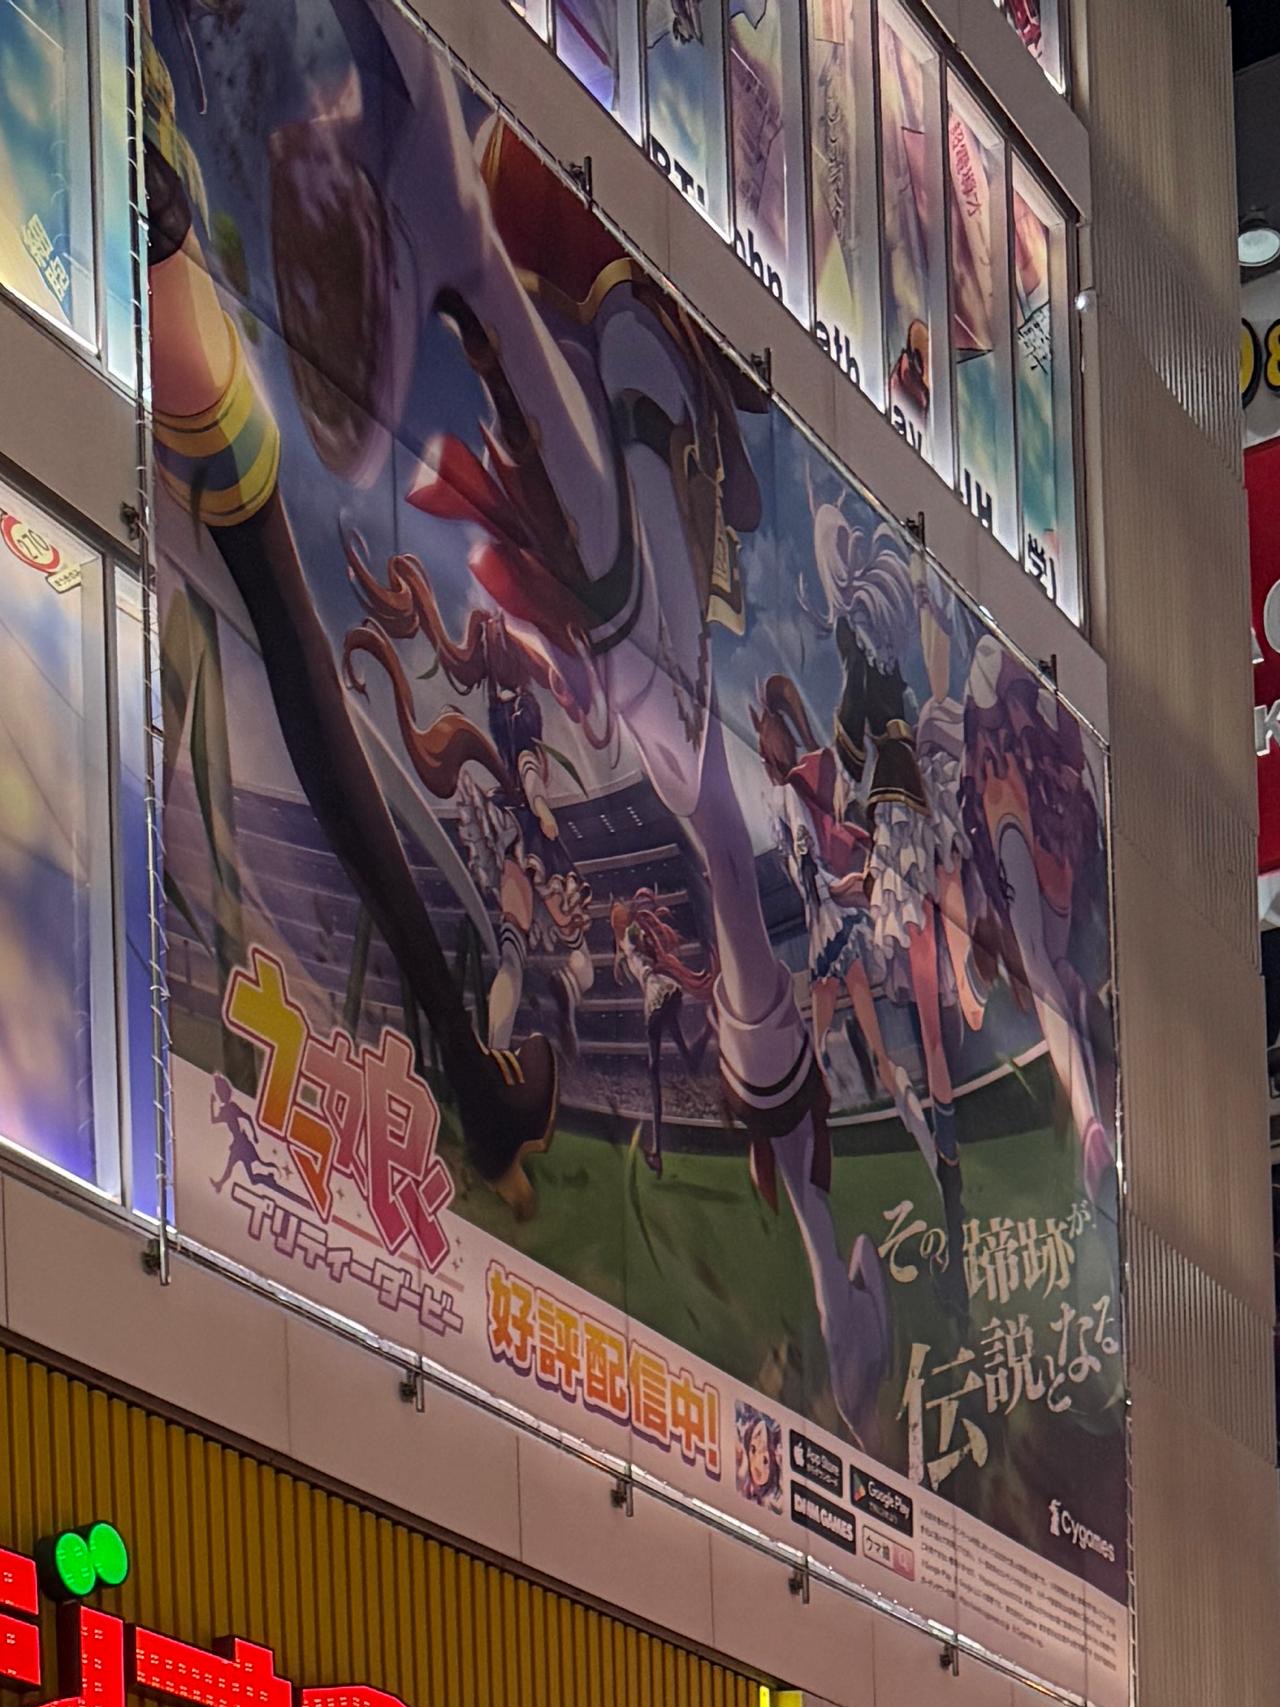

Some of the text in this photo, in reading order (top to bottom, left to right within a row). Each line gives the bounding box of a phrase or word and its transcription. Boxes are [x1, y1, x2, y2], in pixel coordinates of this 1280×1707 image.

[222, 945, 457, 1275] ウマ娘
[230, 1181, 466, 1337] プリティーダービー
[486, 1258, 721, 1482] 好評配信中!
[819, 1508, 854, 1543] GAMES
[867, 1480, 894, 1509] Google
[1060, 1509, 1116, 1563] Cygames
